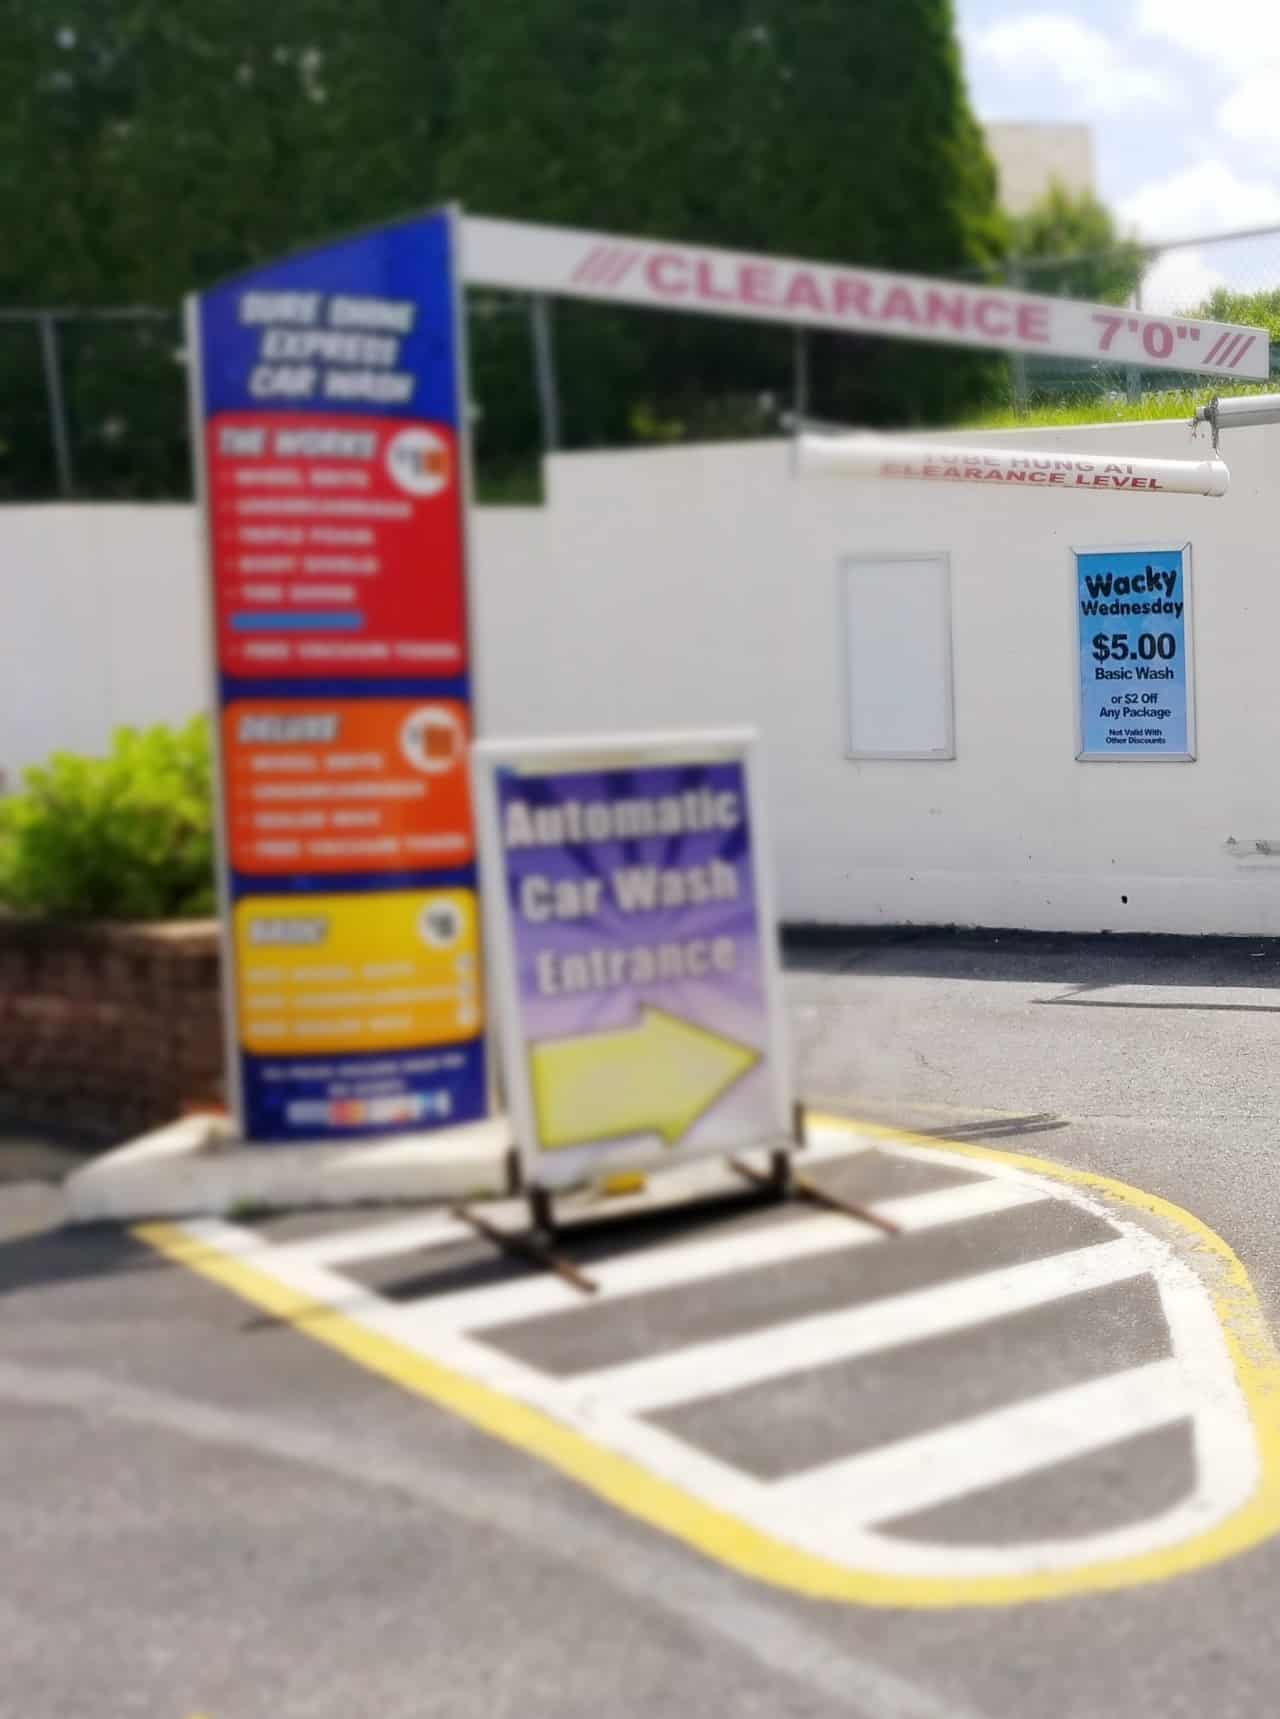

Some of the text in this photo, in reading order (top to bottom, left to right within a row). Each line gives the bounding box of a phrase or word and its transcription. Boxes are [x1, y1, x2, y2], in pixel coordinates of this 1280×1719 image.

[644, 251, 1050, 343] CLEARANCE
[247, 365, 315, 397] CAR
[1011, 458, 1094, 471] HUNG
[1076, 474, 1163, 489] LEVEL
[1085, 565, 1177, 598] Wacky
[1081, 598, 1184, 619] Wednesday
[1092, 632, 1176, 664] $5.00
[1095, 667, 1174, 681] Basic Wash
[1111, 693, 1157, 704] or $2 Off
[1099, 706, 1171, 720] Any Package
[1106, 736, 1166, 744] Other Discounts
[1109, 728, 1162, 736] Not Valid With
[505, 788, 740, 846] Automatic
[519, 858, 738, 922] Car Wash
[535, 936, 738, 995] Entrance
